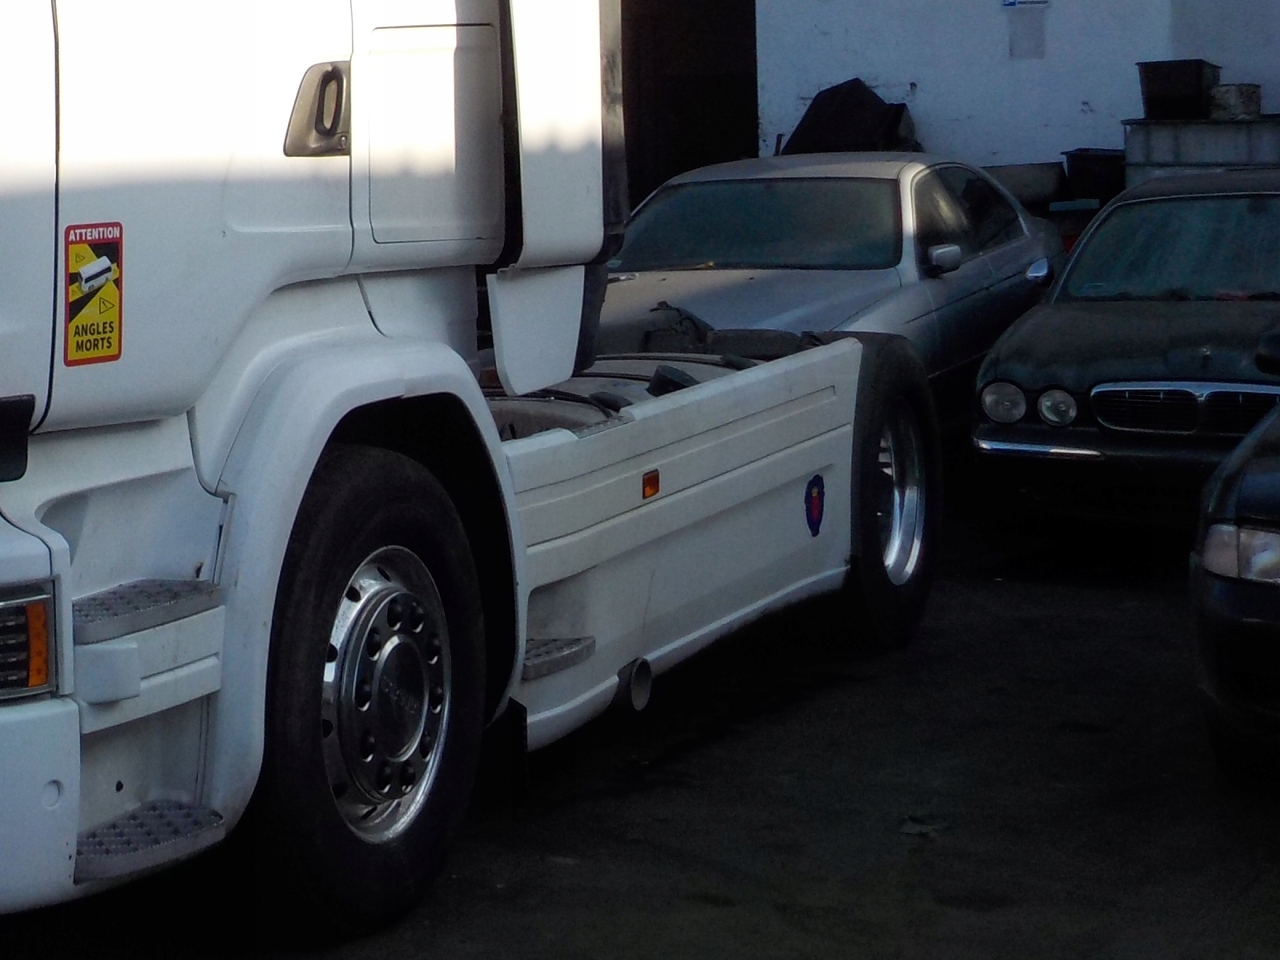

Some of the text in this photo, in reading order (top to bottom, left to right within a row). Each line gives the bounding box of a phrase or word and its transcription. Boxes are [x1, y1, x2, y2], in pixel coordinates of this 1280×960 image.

[68, 226, 120, 242] ATTENTION
[73, 320, 115, 338] ANGLES
[75, 336, 113, 353] MORTS
